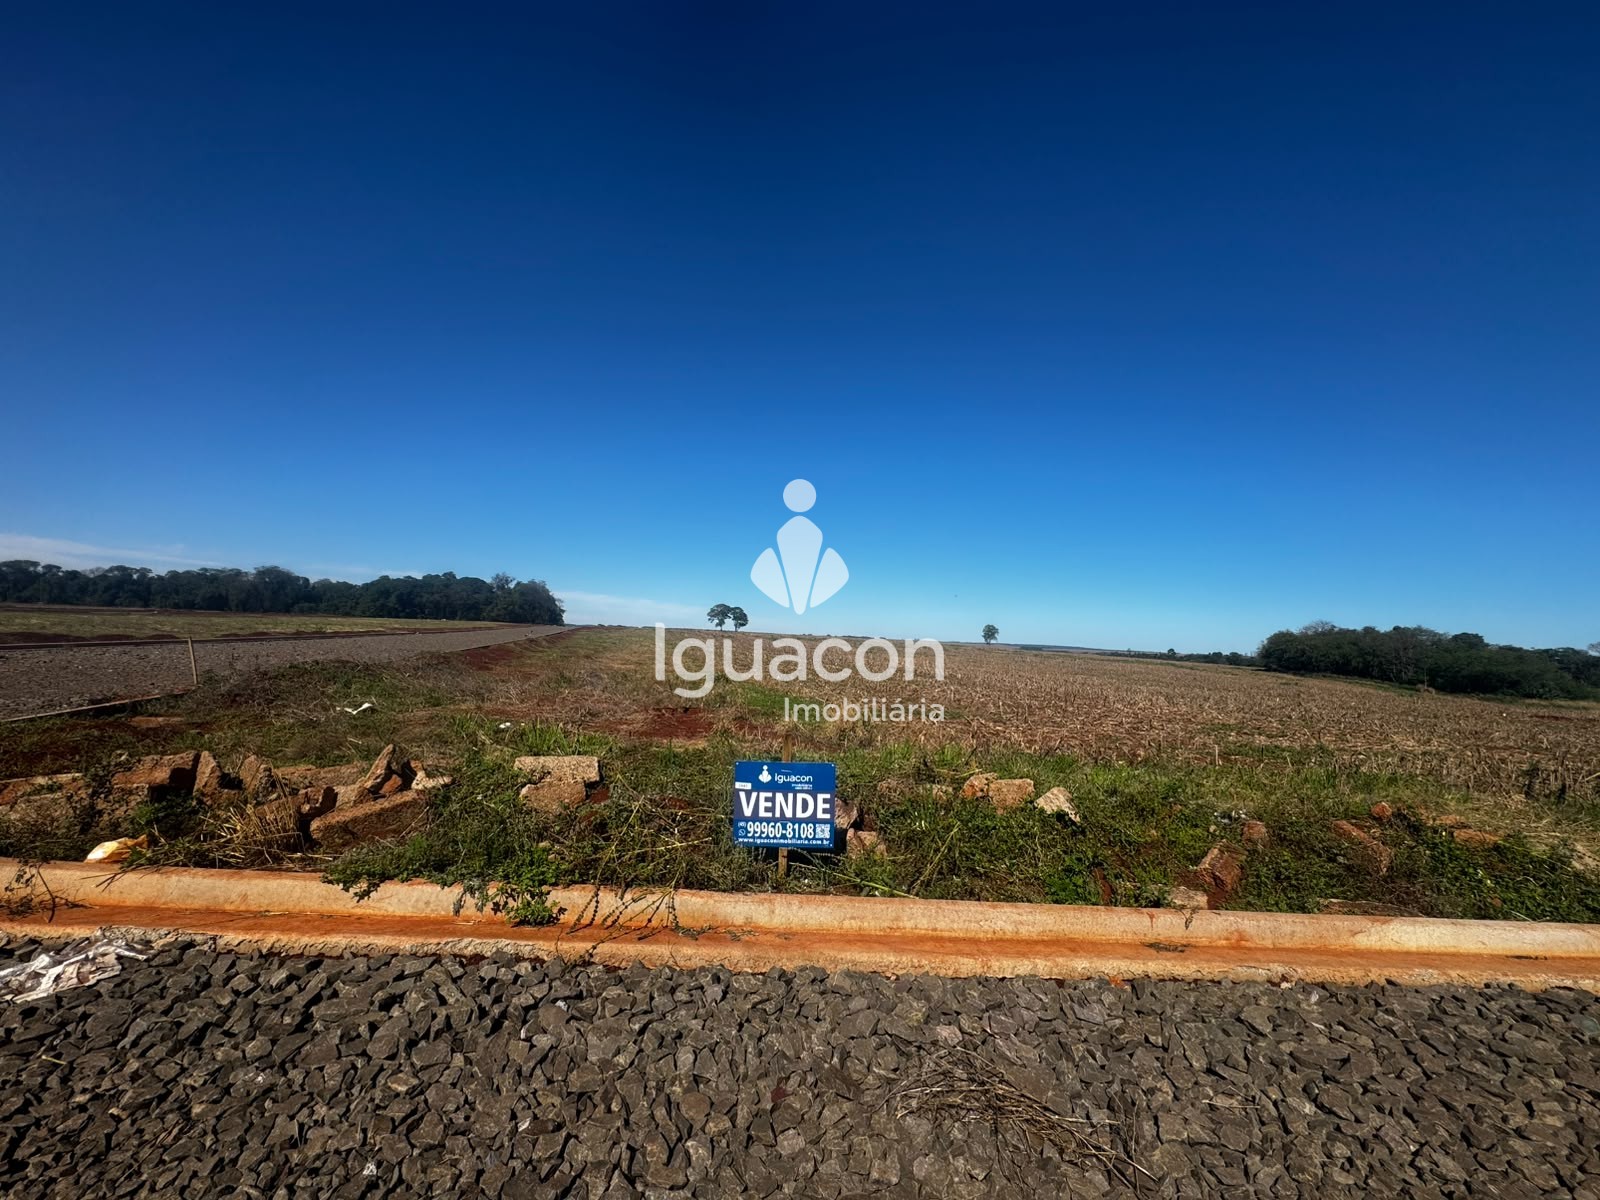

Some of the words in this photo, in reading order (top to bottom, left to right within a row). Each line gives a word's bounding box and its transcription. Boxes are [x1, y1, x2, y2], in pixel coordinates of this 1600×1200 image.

[774, 773, 813, 784] Iguacon
[738, 791, 831, 819] VENDE
[747, 822, 814, 838] 99960-8108
